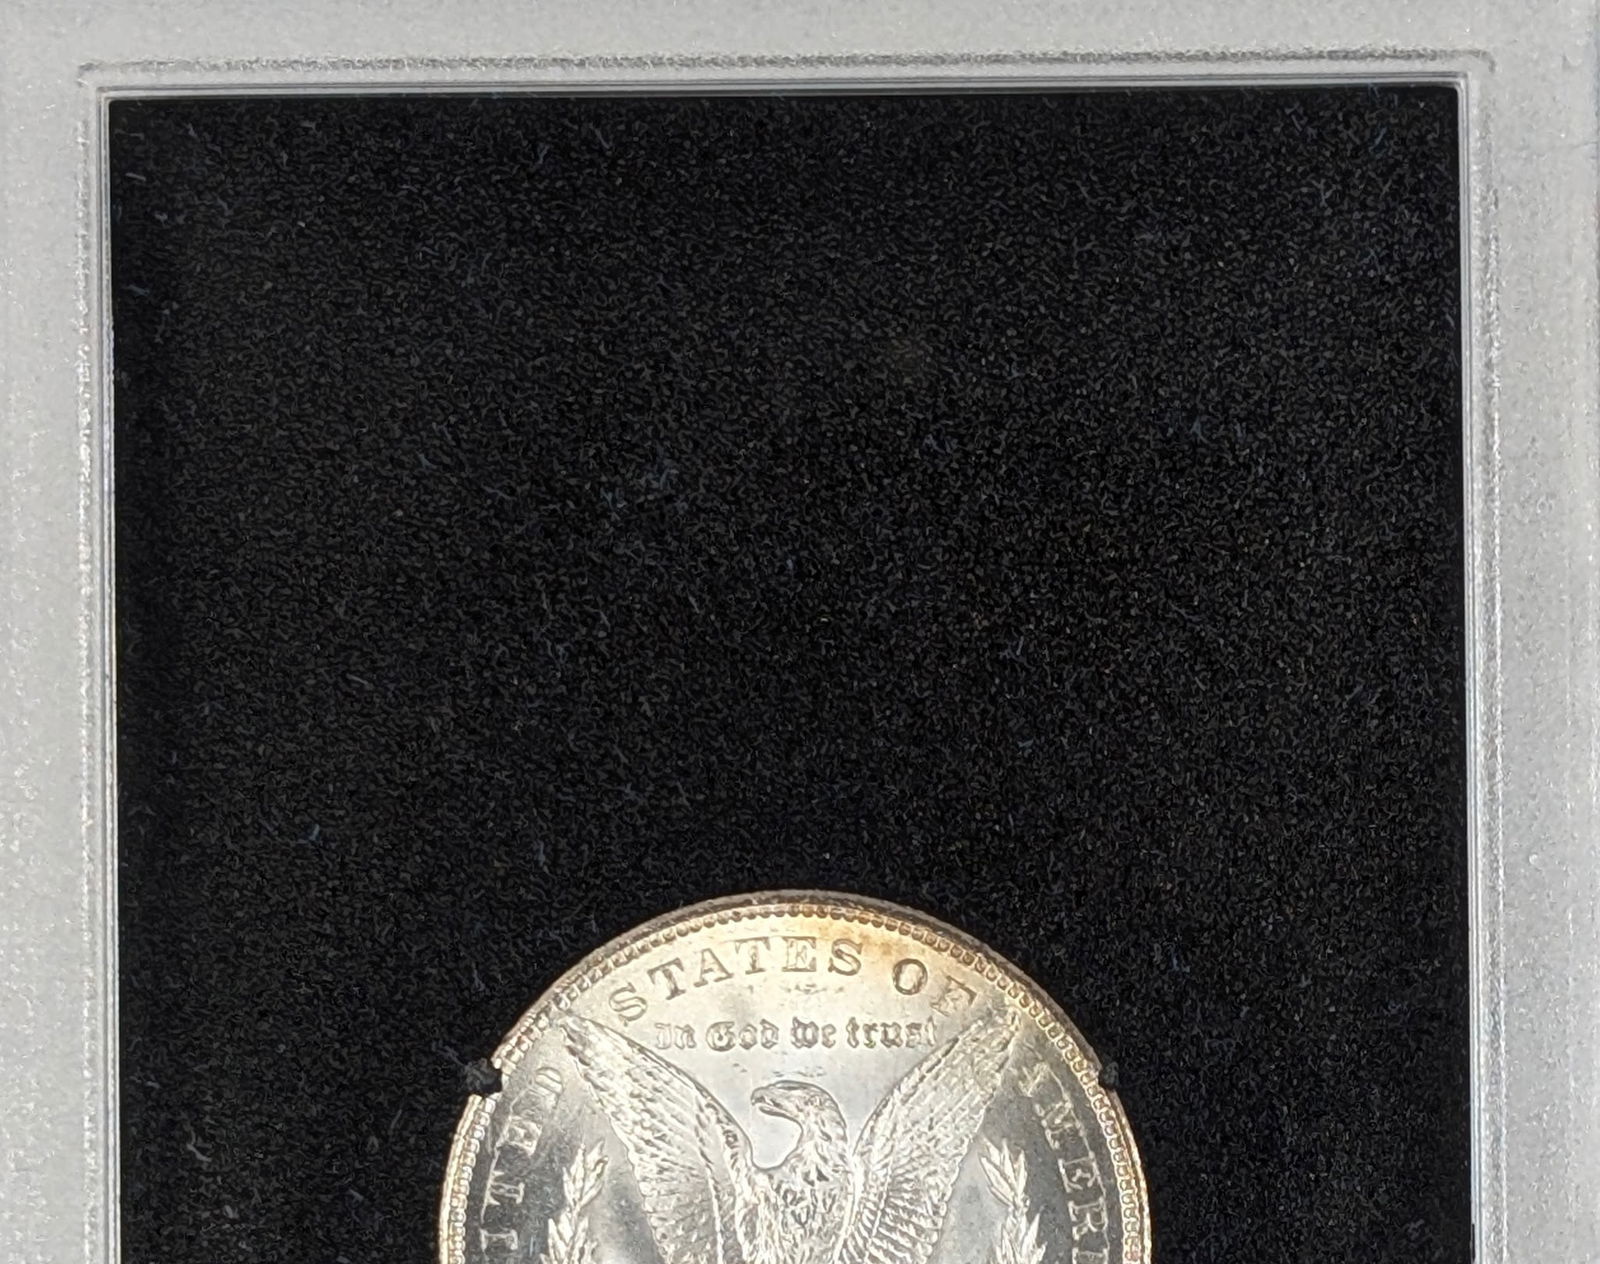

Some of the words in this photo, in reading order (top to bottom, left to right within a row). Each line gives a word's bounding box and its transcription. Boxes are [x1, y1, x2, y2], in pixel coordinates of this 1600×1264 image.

[608, 935, 862, 1027] STATES
[892, 957, 978, 1018] OF
[654, 1021, 698, 1050] In
[705, 1018, 780, 1052] God
[790, 1015, 837, 1049] we
[845, 1014, 936, 1049] trust
